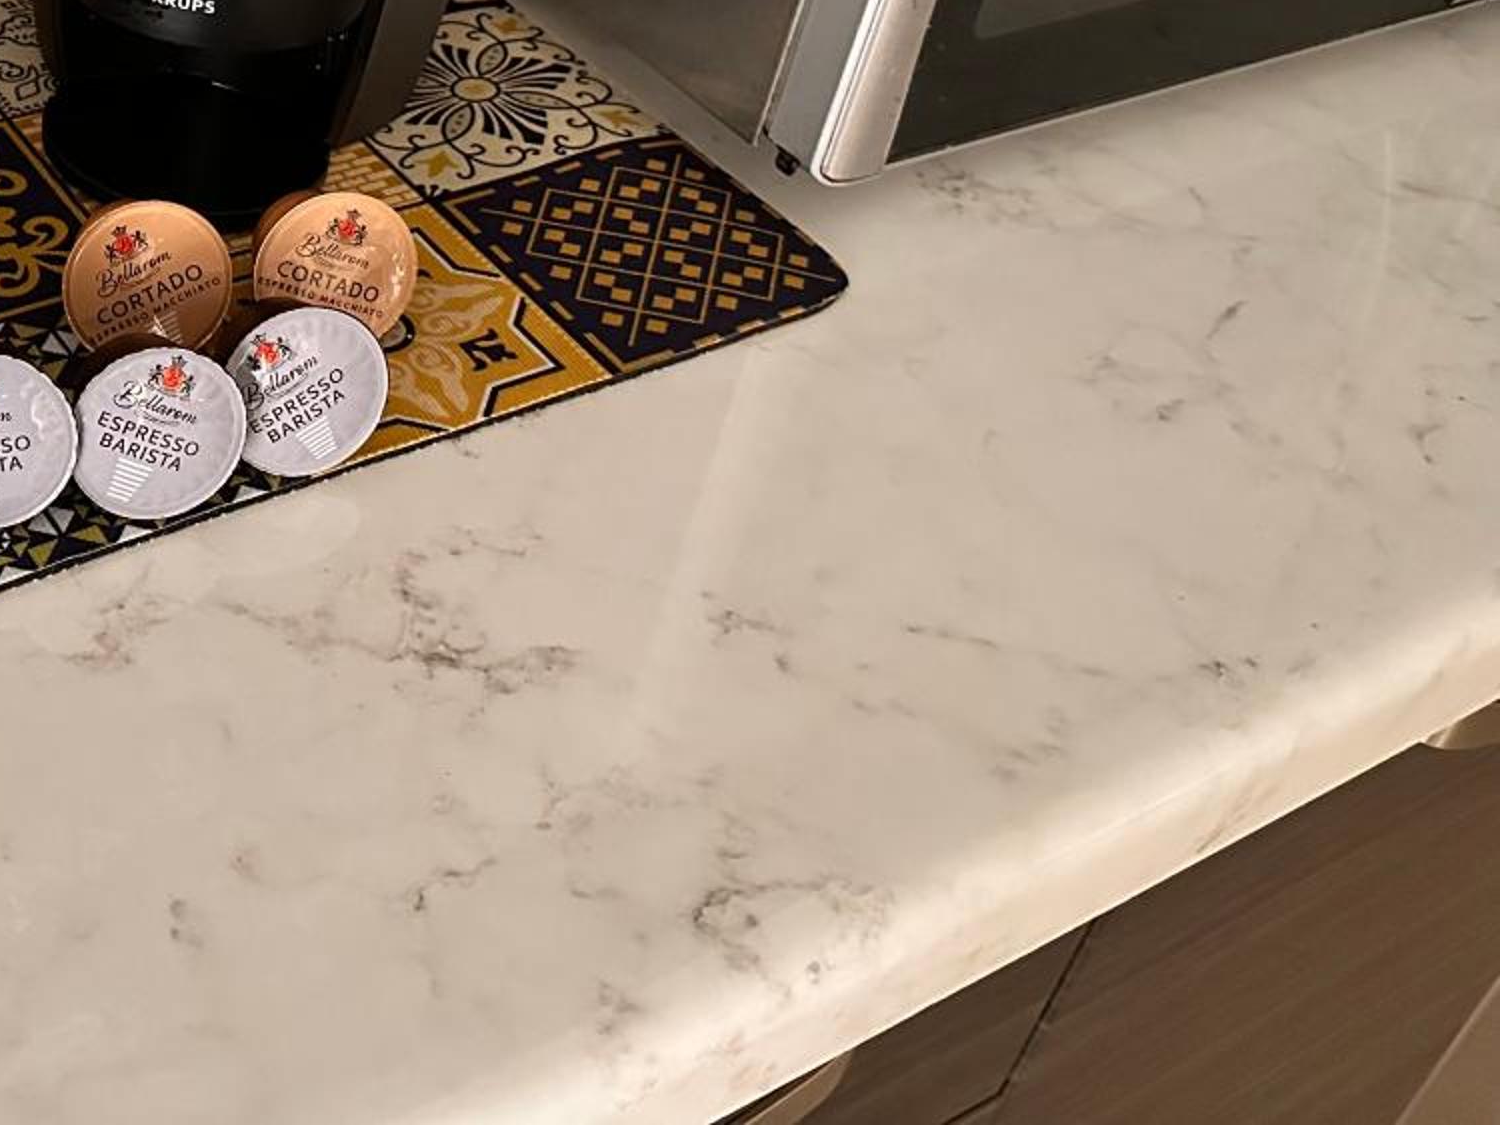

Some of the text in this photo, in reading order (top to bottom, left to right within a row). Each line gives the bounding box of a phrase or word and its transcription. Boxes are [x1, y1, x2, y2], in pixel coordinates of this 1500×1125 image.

[97, 264, 203, 325] CORTADO
[153, 277, 221, 315] MACCHIATO
[277, 260, 380, 303] CORTADO
[319, 295, 384, 319] MACCHIATO
[112, 380, 198, 425] Bellarom
[250, 368, 345, 435] ESPRESSO
[267, 389, 346, 444] BARISTA
[97, 410, 200, 457] ESPRESSO
[99, 432, 182, 472] BARISTA
